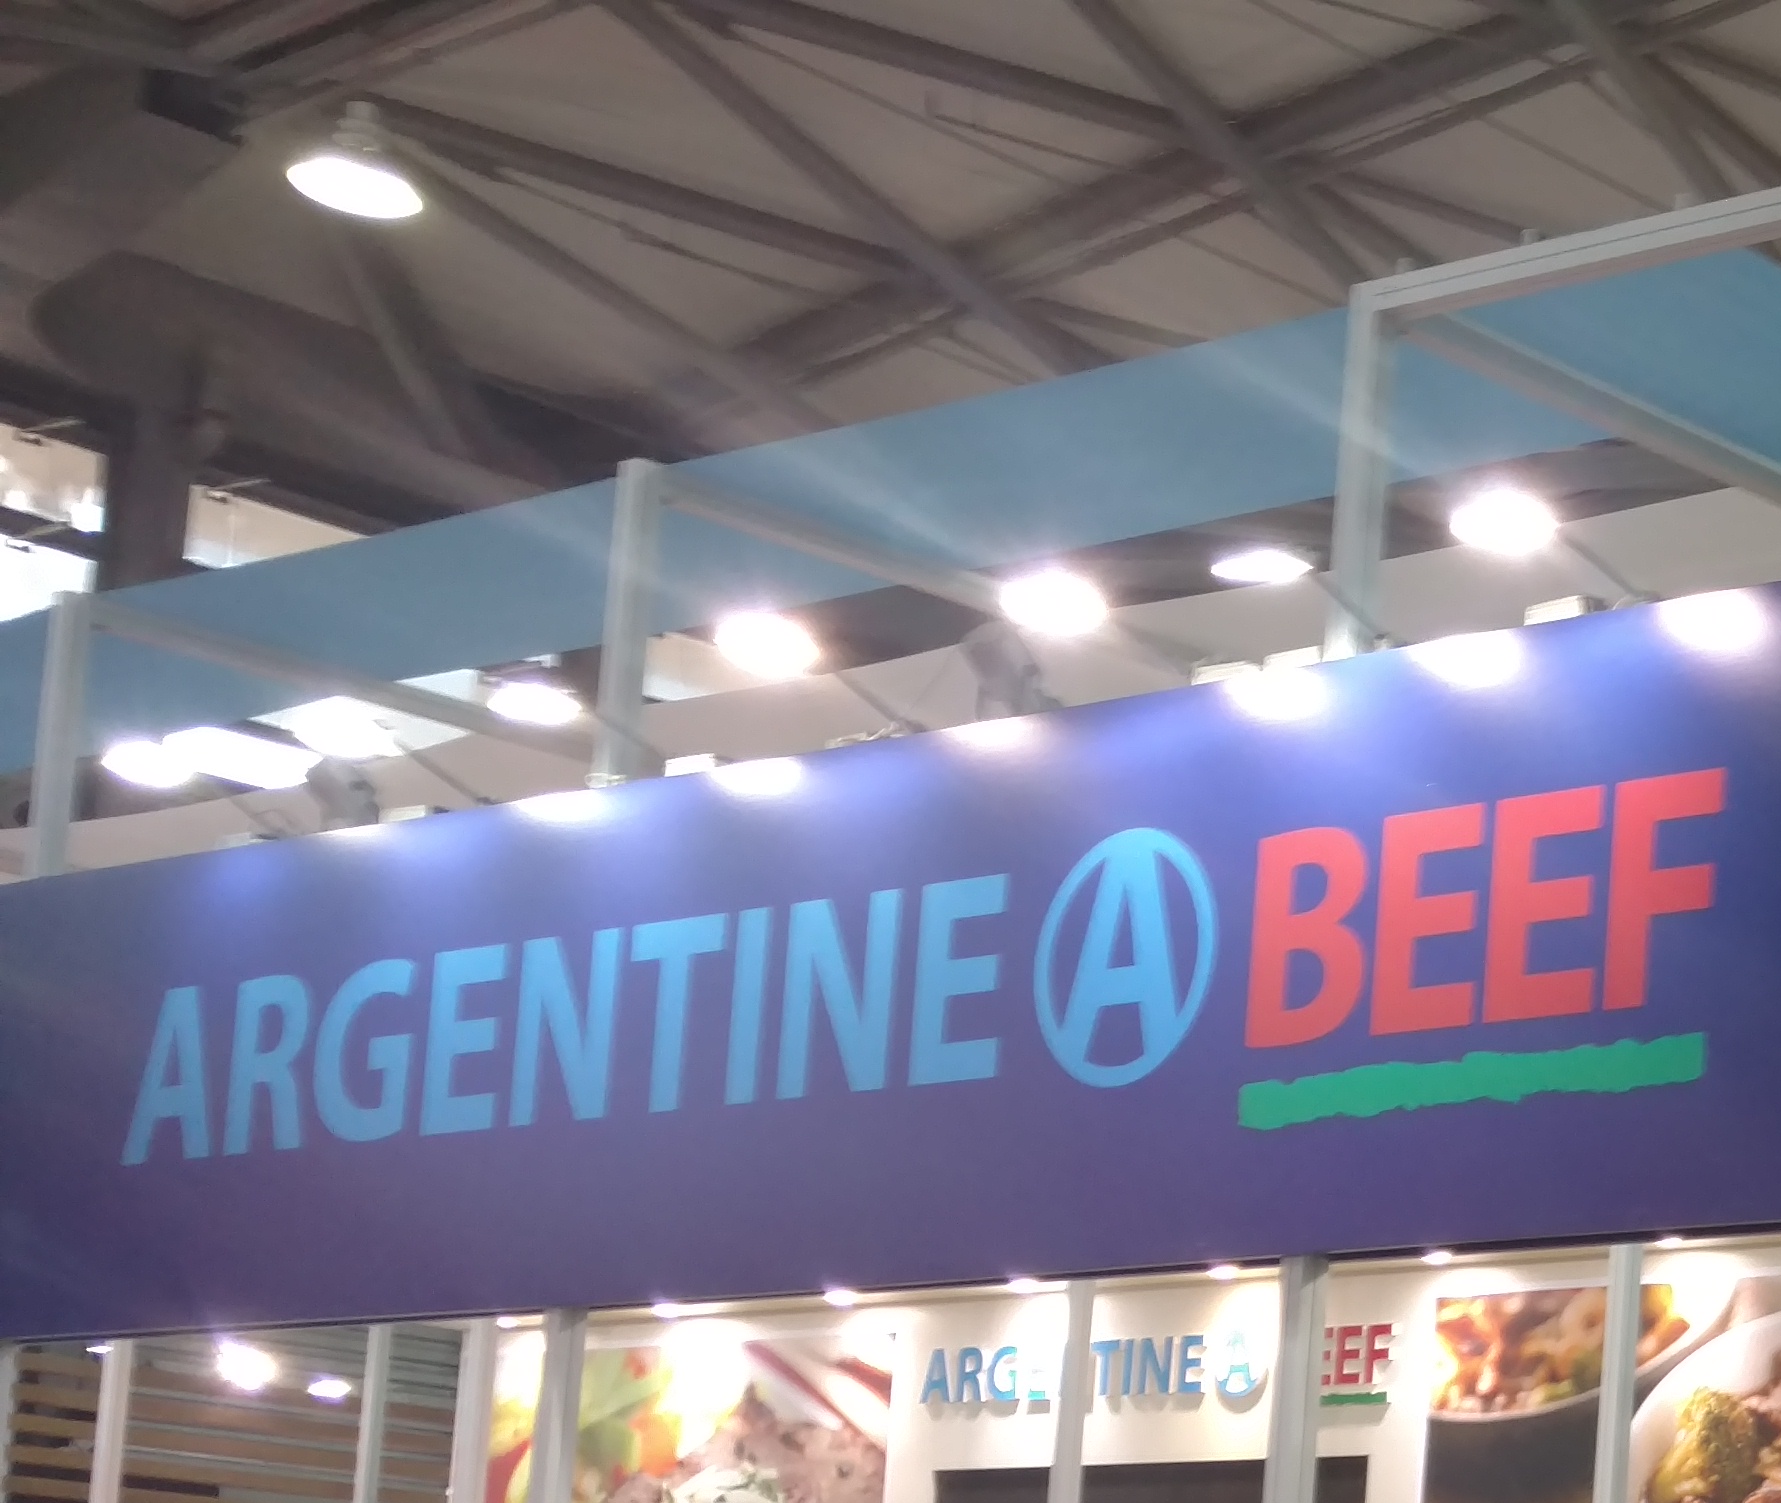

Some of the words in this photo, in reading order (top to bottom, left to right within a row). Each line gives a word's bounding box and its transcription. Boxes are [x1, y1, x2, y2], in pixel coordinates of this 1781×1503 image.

[120, 872, 1010, 1167] ARGENTINE
[1243, 767, 1728, 1049] BEEF
[919, 1335, 1204, 1404] ARGTINE
